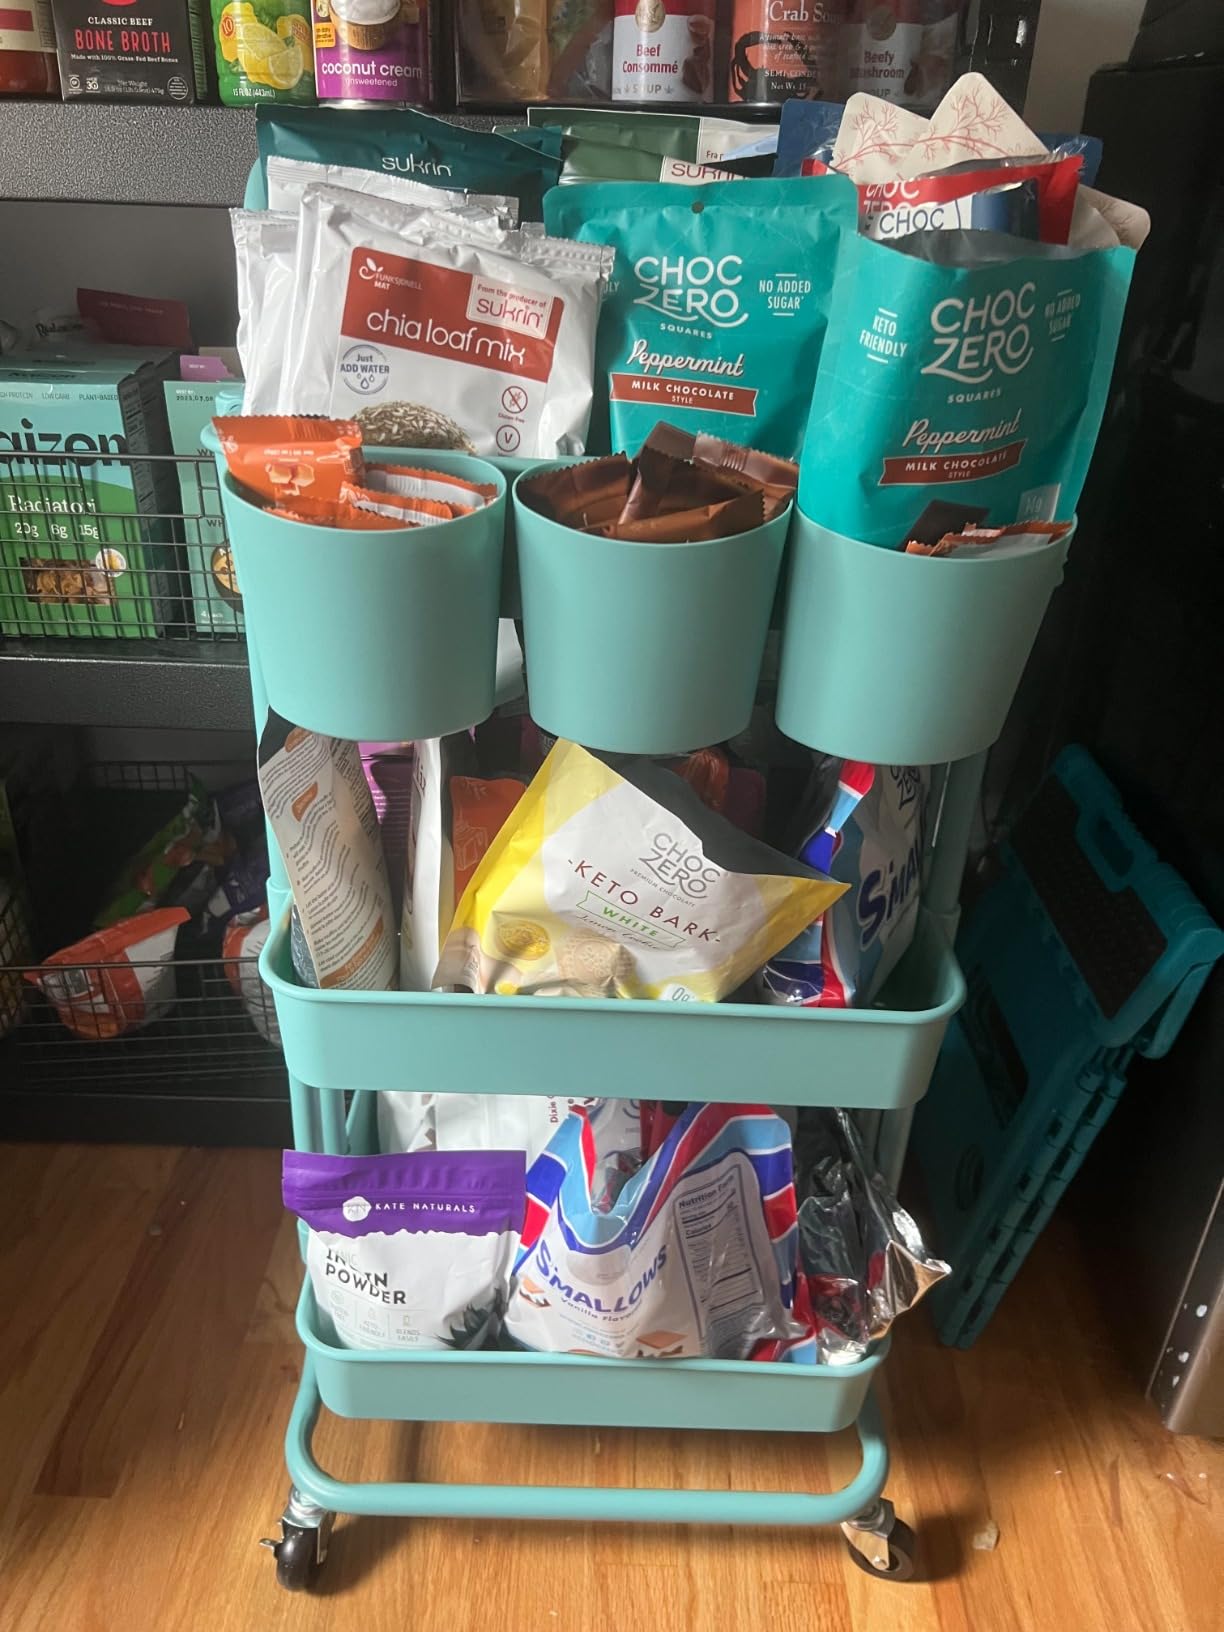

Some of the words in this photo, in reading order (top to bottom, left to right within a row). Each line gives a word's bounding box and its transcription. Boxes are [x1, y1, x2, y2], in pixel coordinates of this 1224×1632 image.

[87, 16, 128, 26] CLASSIC
[129, 17, 153, 26] BEEF
[769, 0, 809, 22] Crab
[75, 28, 115, 51] BONE
[121, 30, 171, 53] BROTH
[636, 43, 661, 57] Beef
[70, 53, 86, 61] Made
[622, 60, 678, 74] Consommé
[863, 50, 895, 66] Beefy
[321, 60, 377, 76] coconut
[379, 63, 423, 79] cream
[345, 77, 398, 87] unsweetened
[632, 83, 662, 94] SUP
[382, 152, 452, 177] sukrin
[879, 208, 945, 234] CHOC
[633, 254, 743, 286] CHOC
[373, 281, 391, 291] MAT
[477, 283, 496, 294] From
[508, 293, 539, 307] producer
[538, 301, 547, 309] of
[758, 278, 774, 294] NO
[776, 279, 812, 294] ADDED
[476, 298, 543, 329] sukrin
[632, 282, 749, 328] ZERO
[767, 295, 804, 310] SUGAR
[930, 281, 1037, 335] CHOC
[659, 321, 713, 340] SQUARES
[872, 314, 897, 336] KETO
[366, 308, 422, 341] chia
[425, 318, 479, 352] loaf
[475, 336, 527, 366] mix
[858, 330, 909, 358] FRIENDLY
[355, 353, 373, 363] Just
[626, 338, 745, 377] Peppermint
[920, 322, 1036, 384] ZERO
[340, 363, 359, 373] ADD
[359, 363, 390, 375] WATER
[631, 379, 661, 393] MILK
[665, 381, 735, 401] CHOCOLATE
[671, 394, 694, 405] STYLE
[946, 387, 1002, 404] SQUARES
[901, 406, 1023, 454] Peppermint
[904, 458, 938, 472] MILK
[943, 451, 1008, 471] CHOCOLATE
[948, 469, 971, 479] STYLE
[14, 522, 39, 538] 20g
[50, 523, 69, 539] 6g
[79, 524, 100, 539] 15g
[653, 832, 721, 884] CHOC
[638, 847, 708, 899] ZERO
[629, 867, 659, 892] PREMIUM
[658, 886, 696, 908] CHOCOLATE
[574, 859, 639, 906] KETO
[649, 905, 717, 943] BARK
[601, 905, 660, 938] WHITE
[547, 1101, 559, 1124] Dixie
[375, 1201, 406, 1211] KATE
[412, 1202, 476, 1214] NATURALS
[678, 1188, 718, 1210] Nutrition
[325, 1262, 407, 1305] POWDER
[560, 1297, 599, 1320] Vanilla
